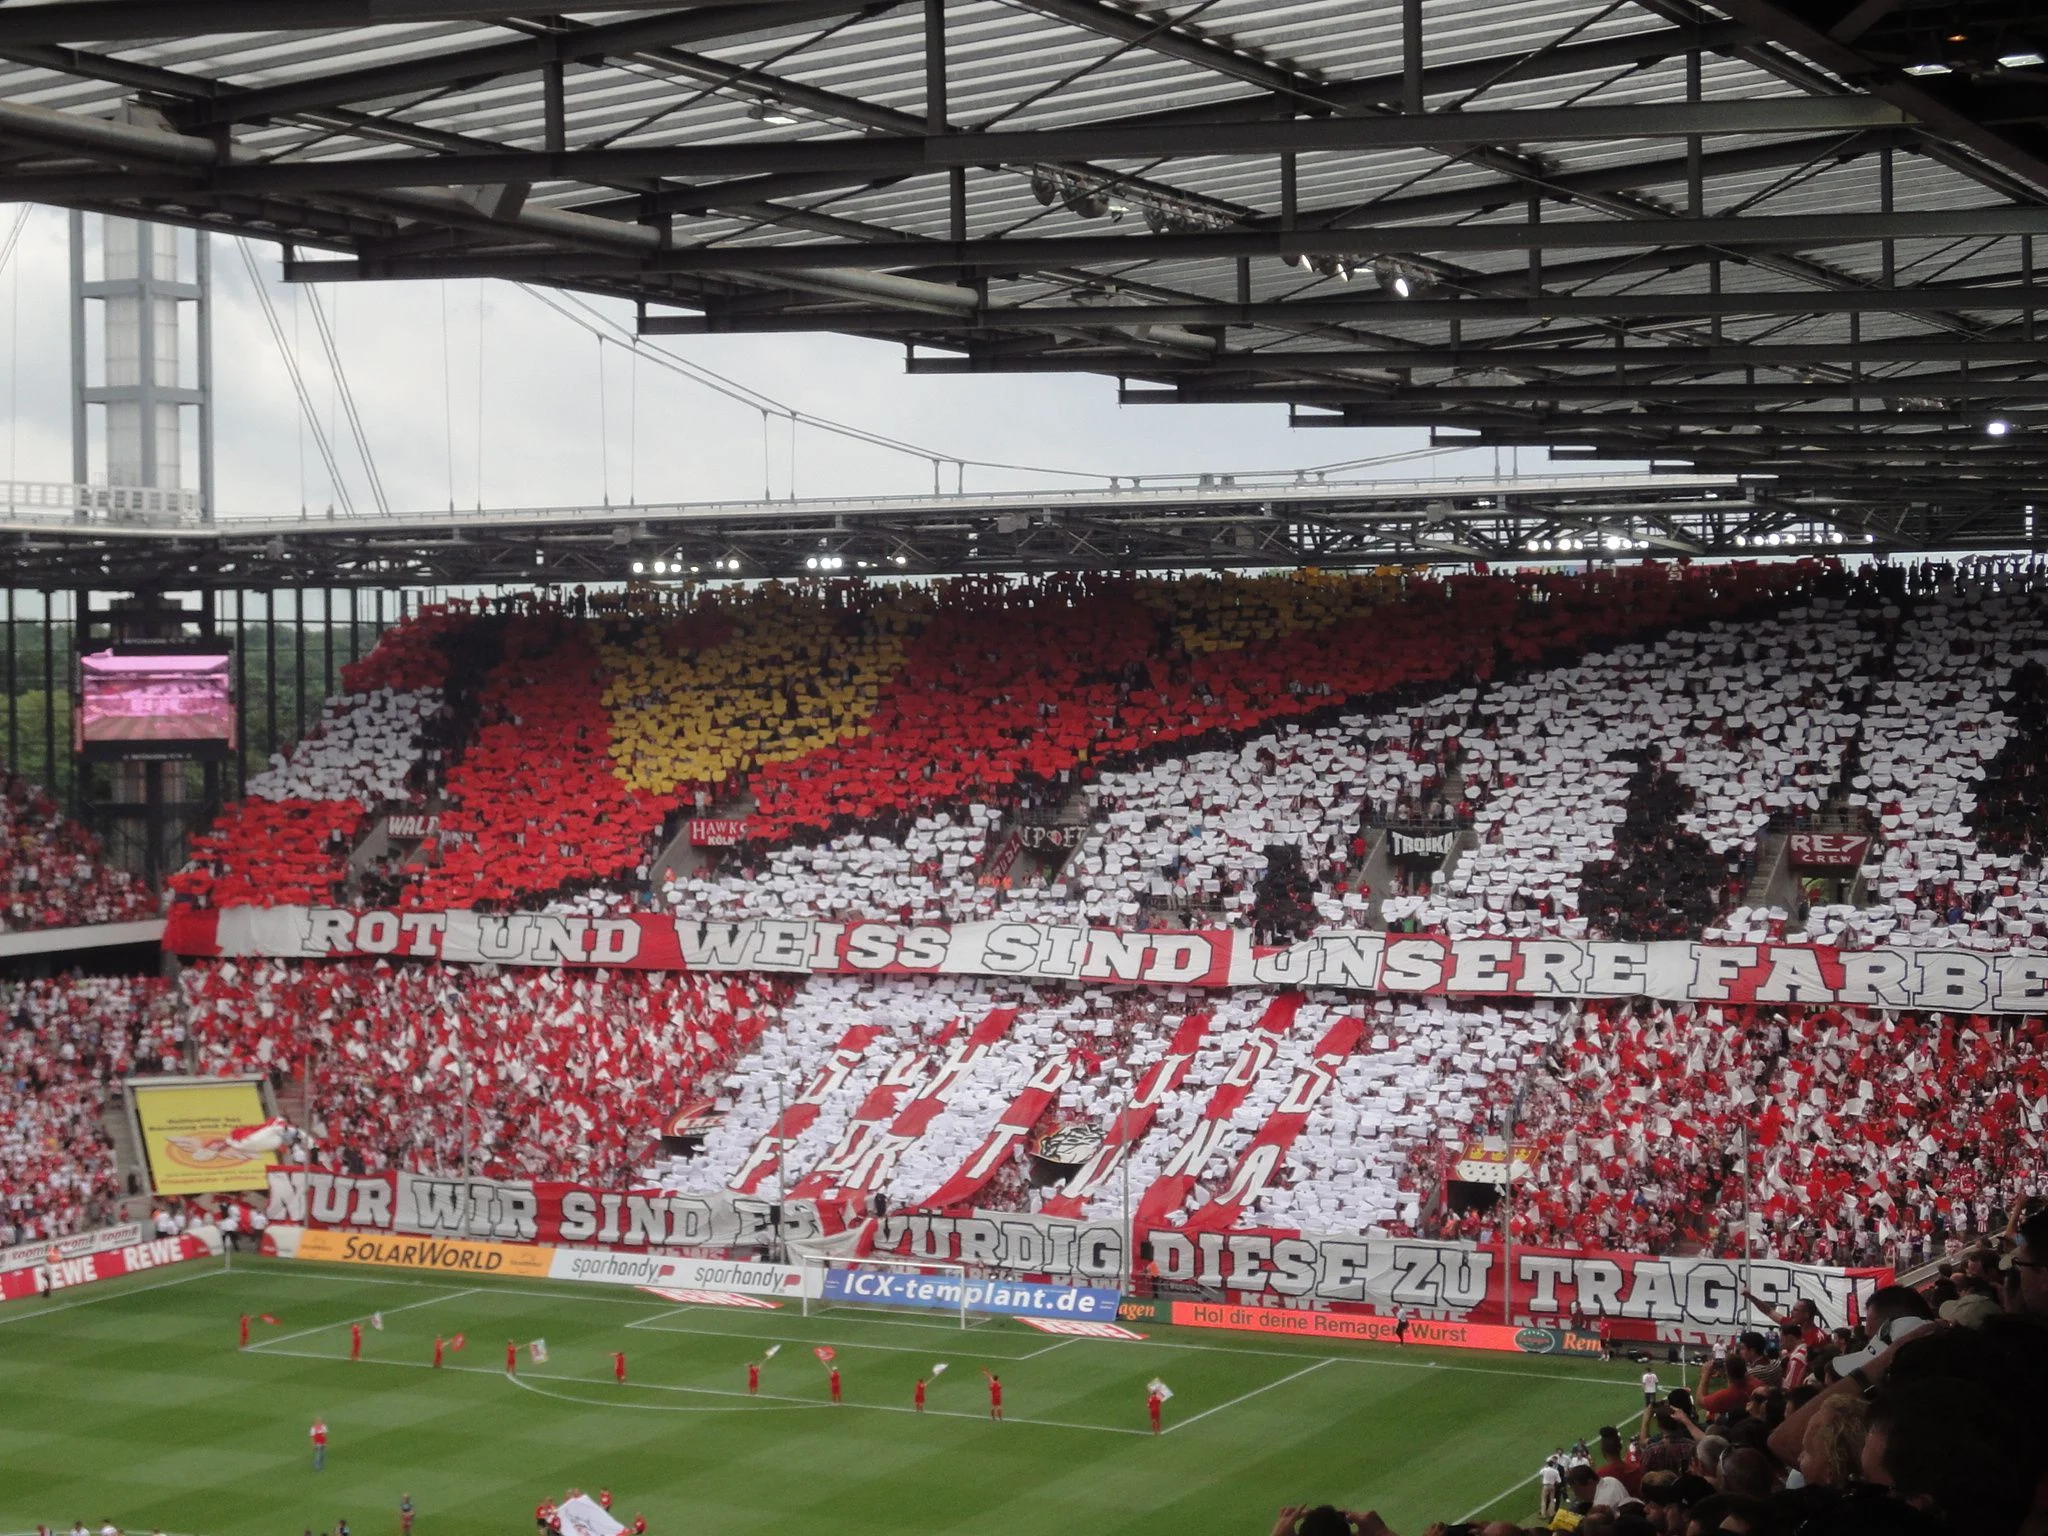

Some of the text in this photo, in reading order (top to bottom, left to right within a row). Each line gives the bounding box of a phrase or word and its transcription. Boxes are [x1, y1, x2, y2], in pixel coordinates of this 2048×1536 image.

[1392, 831, 1454, 856] TROIKA
[1802, 854, 1852, 864] CREW
[303, 908, 2048, 1011] ROT UND WEISS SIND UNSERE FARBE
[124, 1237, 184, 1272] REWE
[266, 1170, 393, 1229] NUR
[412, 1180, 538, 1240] WIR
[560, 1191, 712, 1246] SIND
[1148, 1230, 1369, 1301] DIESE
[1391, 1245, 1493, 1308] ZU
[844, 1272, 1096, 1313] ICX-templant.de
[1194, 1306, 1226, 1323] Hol
[1230, 1308, 1254, 1325] dir
[1259, 1310, 1308, 1329] deine
